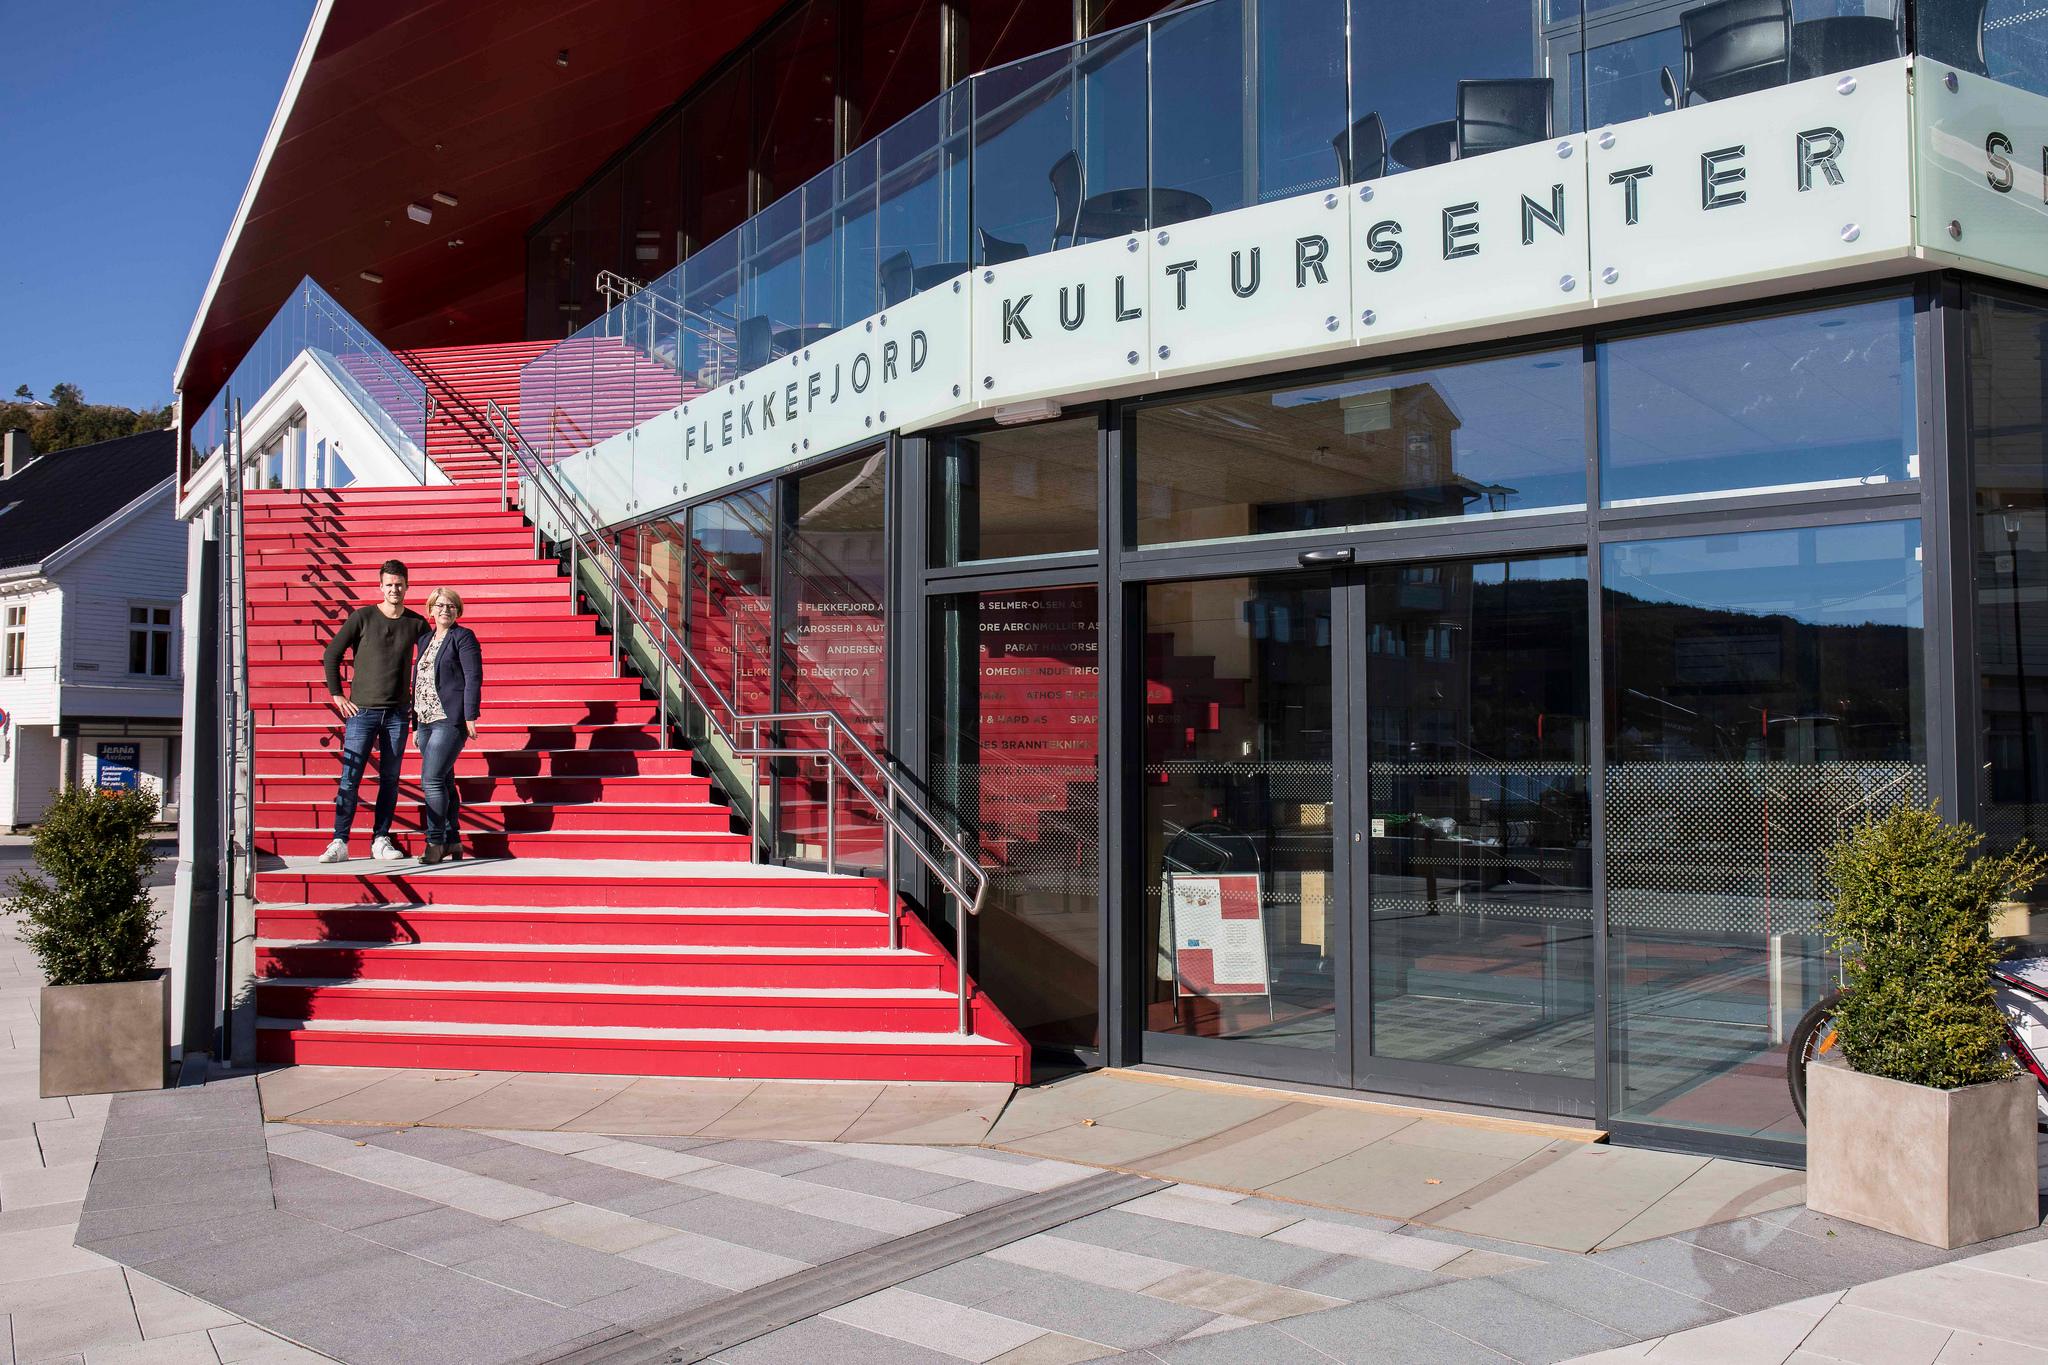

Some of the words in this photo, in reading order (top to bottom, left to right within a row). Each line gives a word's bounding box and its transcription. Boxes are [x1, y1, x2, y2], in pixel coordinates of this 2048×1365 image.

[1985, 130, 2048, 206] S
[685, 329, 928, 461] FLEKKEFJORD
[1002, 126, 1845, 345] KULTURSENTER
[805, 603, 875, 611] FLEKKEFJORD
[979, 601, 986, 610] &
[797, 624, 853, 633] KAROSSERI
[856, 624, 863, 632] &
[827, 645, 884, 654] ANDERSEN
[811, 668, 858, 676] ELEKTRO
